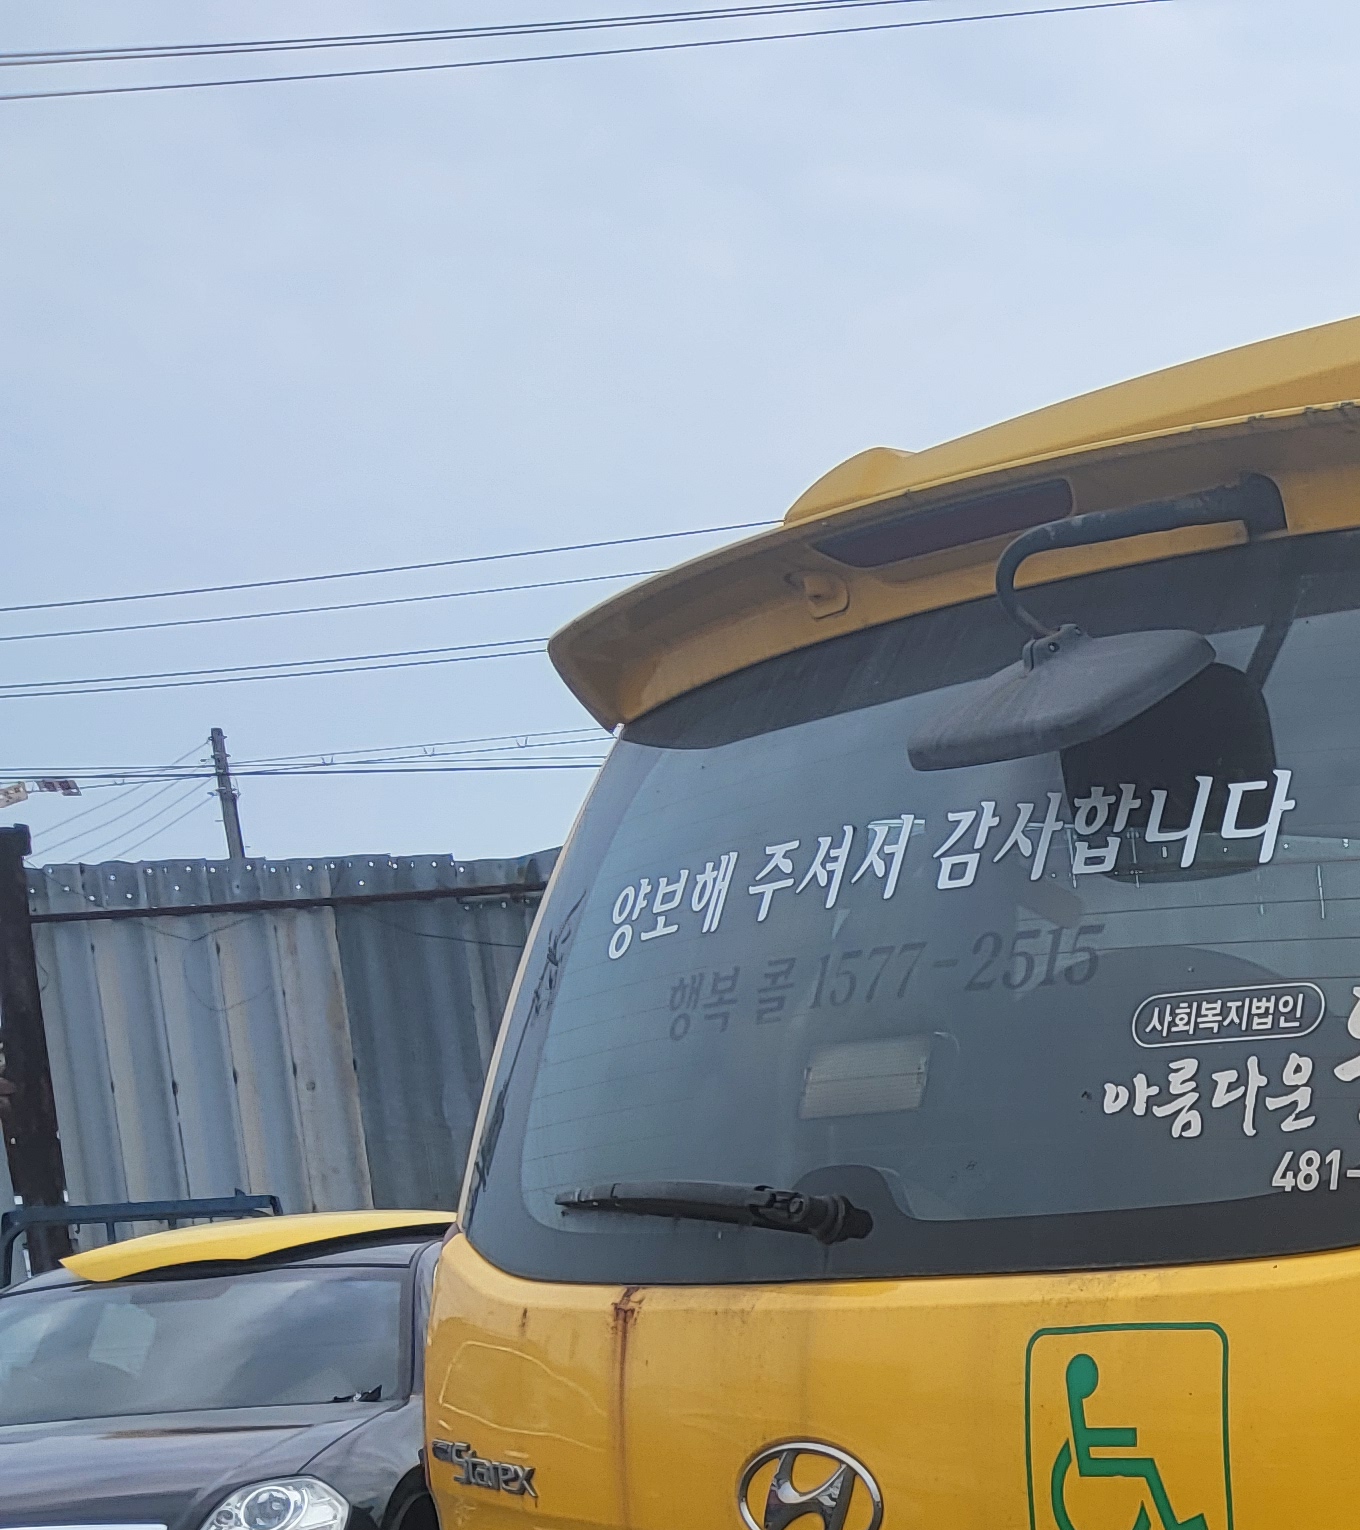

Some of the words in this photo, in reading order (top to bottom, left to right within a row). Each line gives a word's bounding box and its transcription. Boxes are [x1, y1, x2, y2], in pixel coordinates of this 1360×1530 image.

[607, 851, 739, 960] 양보해
[747, 814, 916, 923] 주셔서
[933, 768, 1297, 890] 감사합니다
[809, 922, 1106, 1010] 1577-2515
[1144, 993, 1305, 1038] 사회복지법인
[1103, 1052, 1318, 1139] 아름다운
